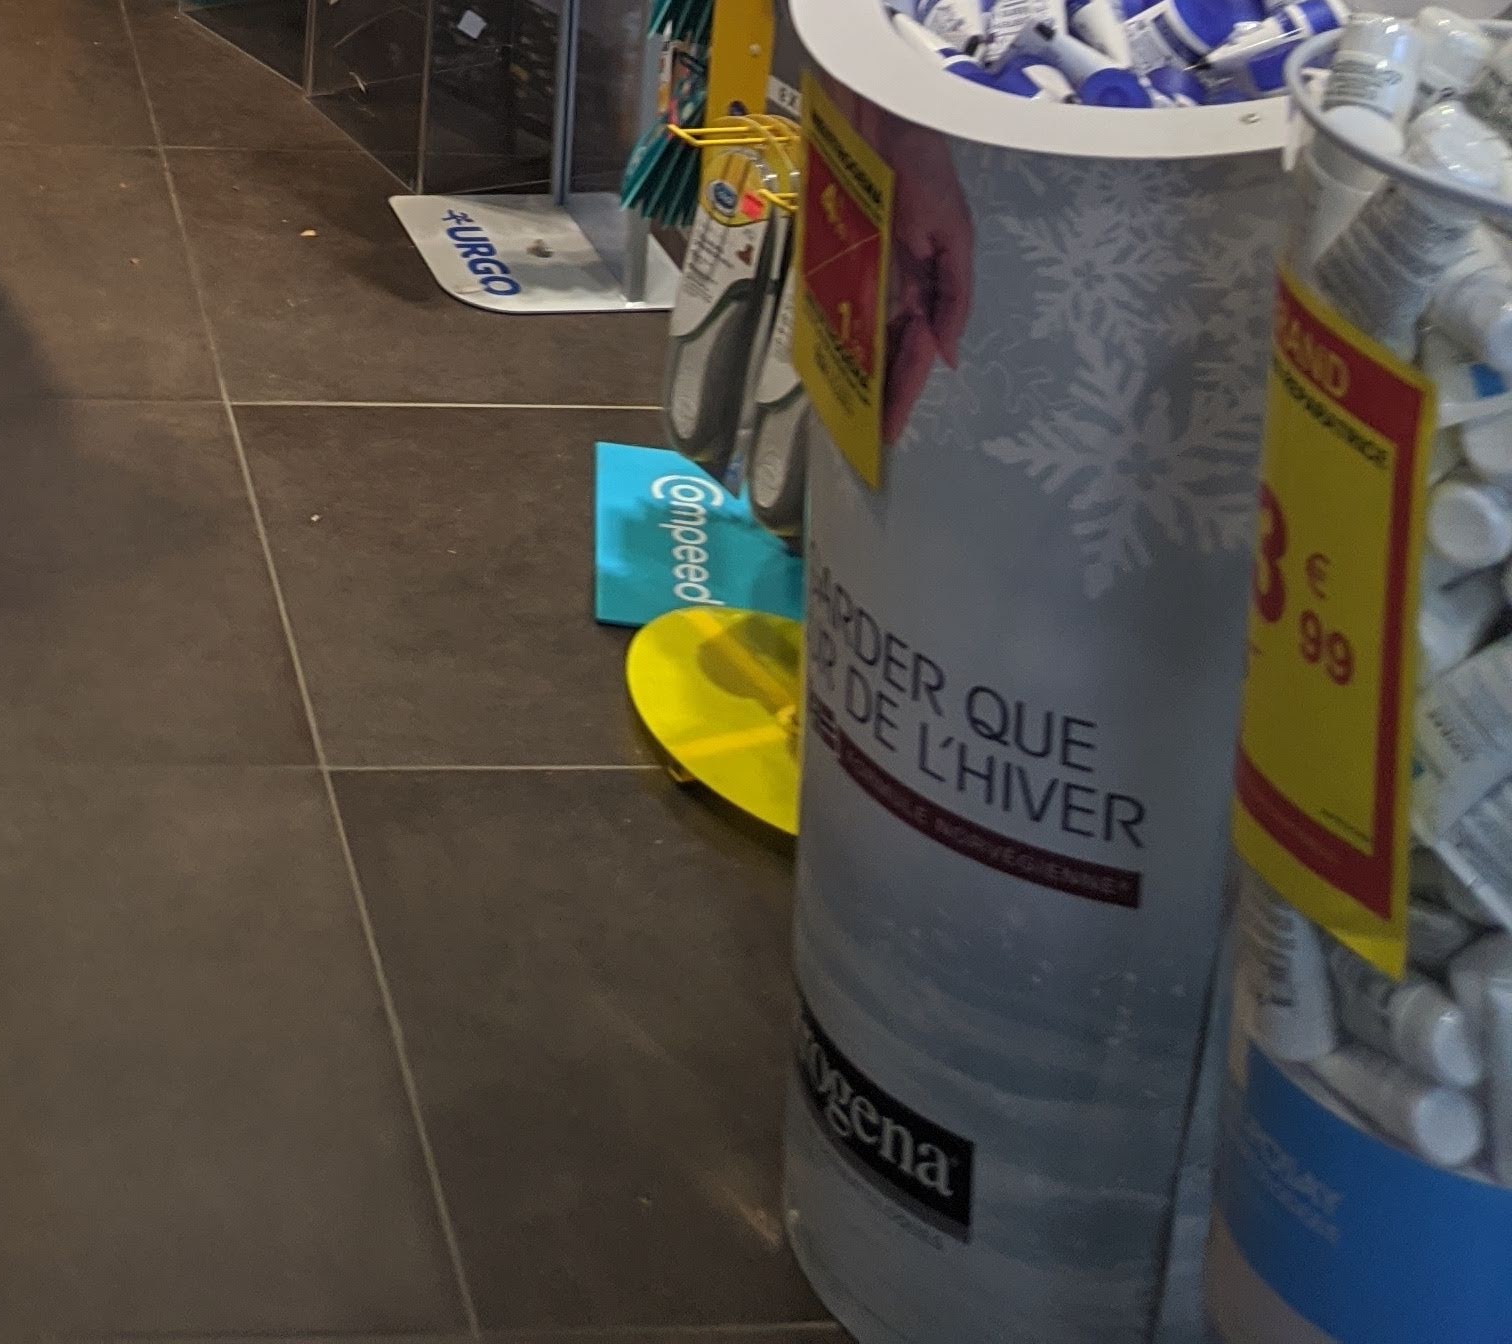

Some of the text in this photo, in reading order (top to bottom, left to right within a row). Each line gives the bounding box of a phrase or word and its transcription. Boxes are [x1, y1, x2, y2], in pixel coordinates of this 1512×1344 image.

[445, 224, 522, 298] URGO
[650, 473, 725, 607] Compeed
[1304, 552, 1333, 602] €
[1299, 610, 1356, 687] 99
[845, 664, 1145, 849] DE L'HIVER
[965, 685, 1098, 774] QUE
